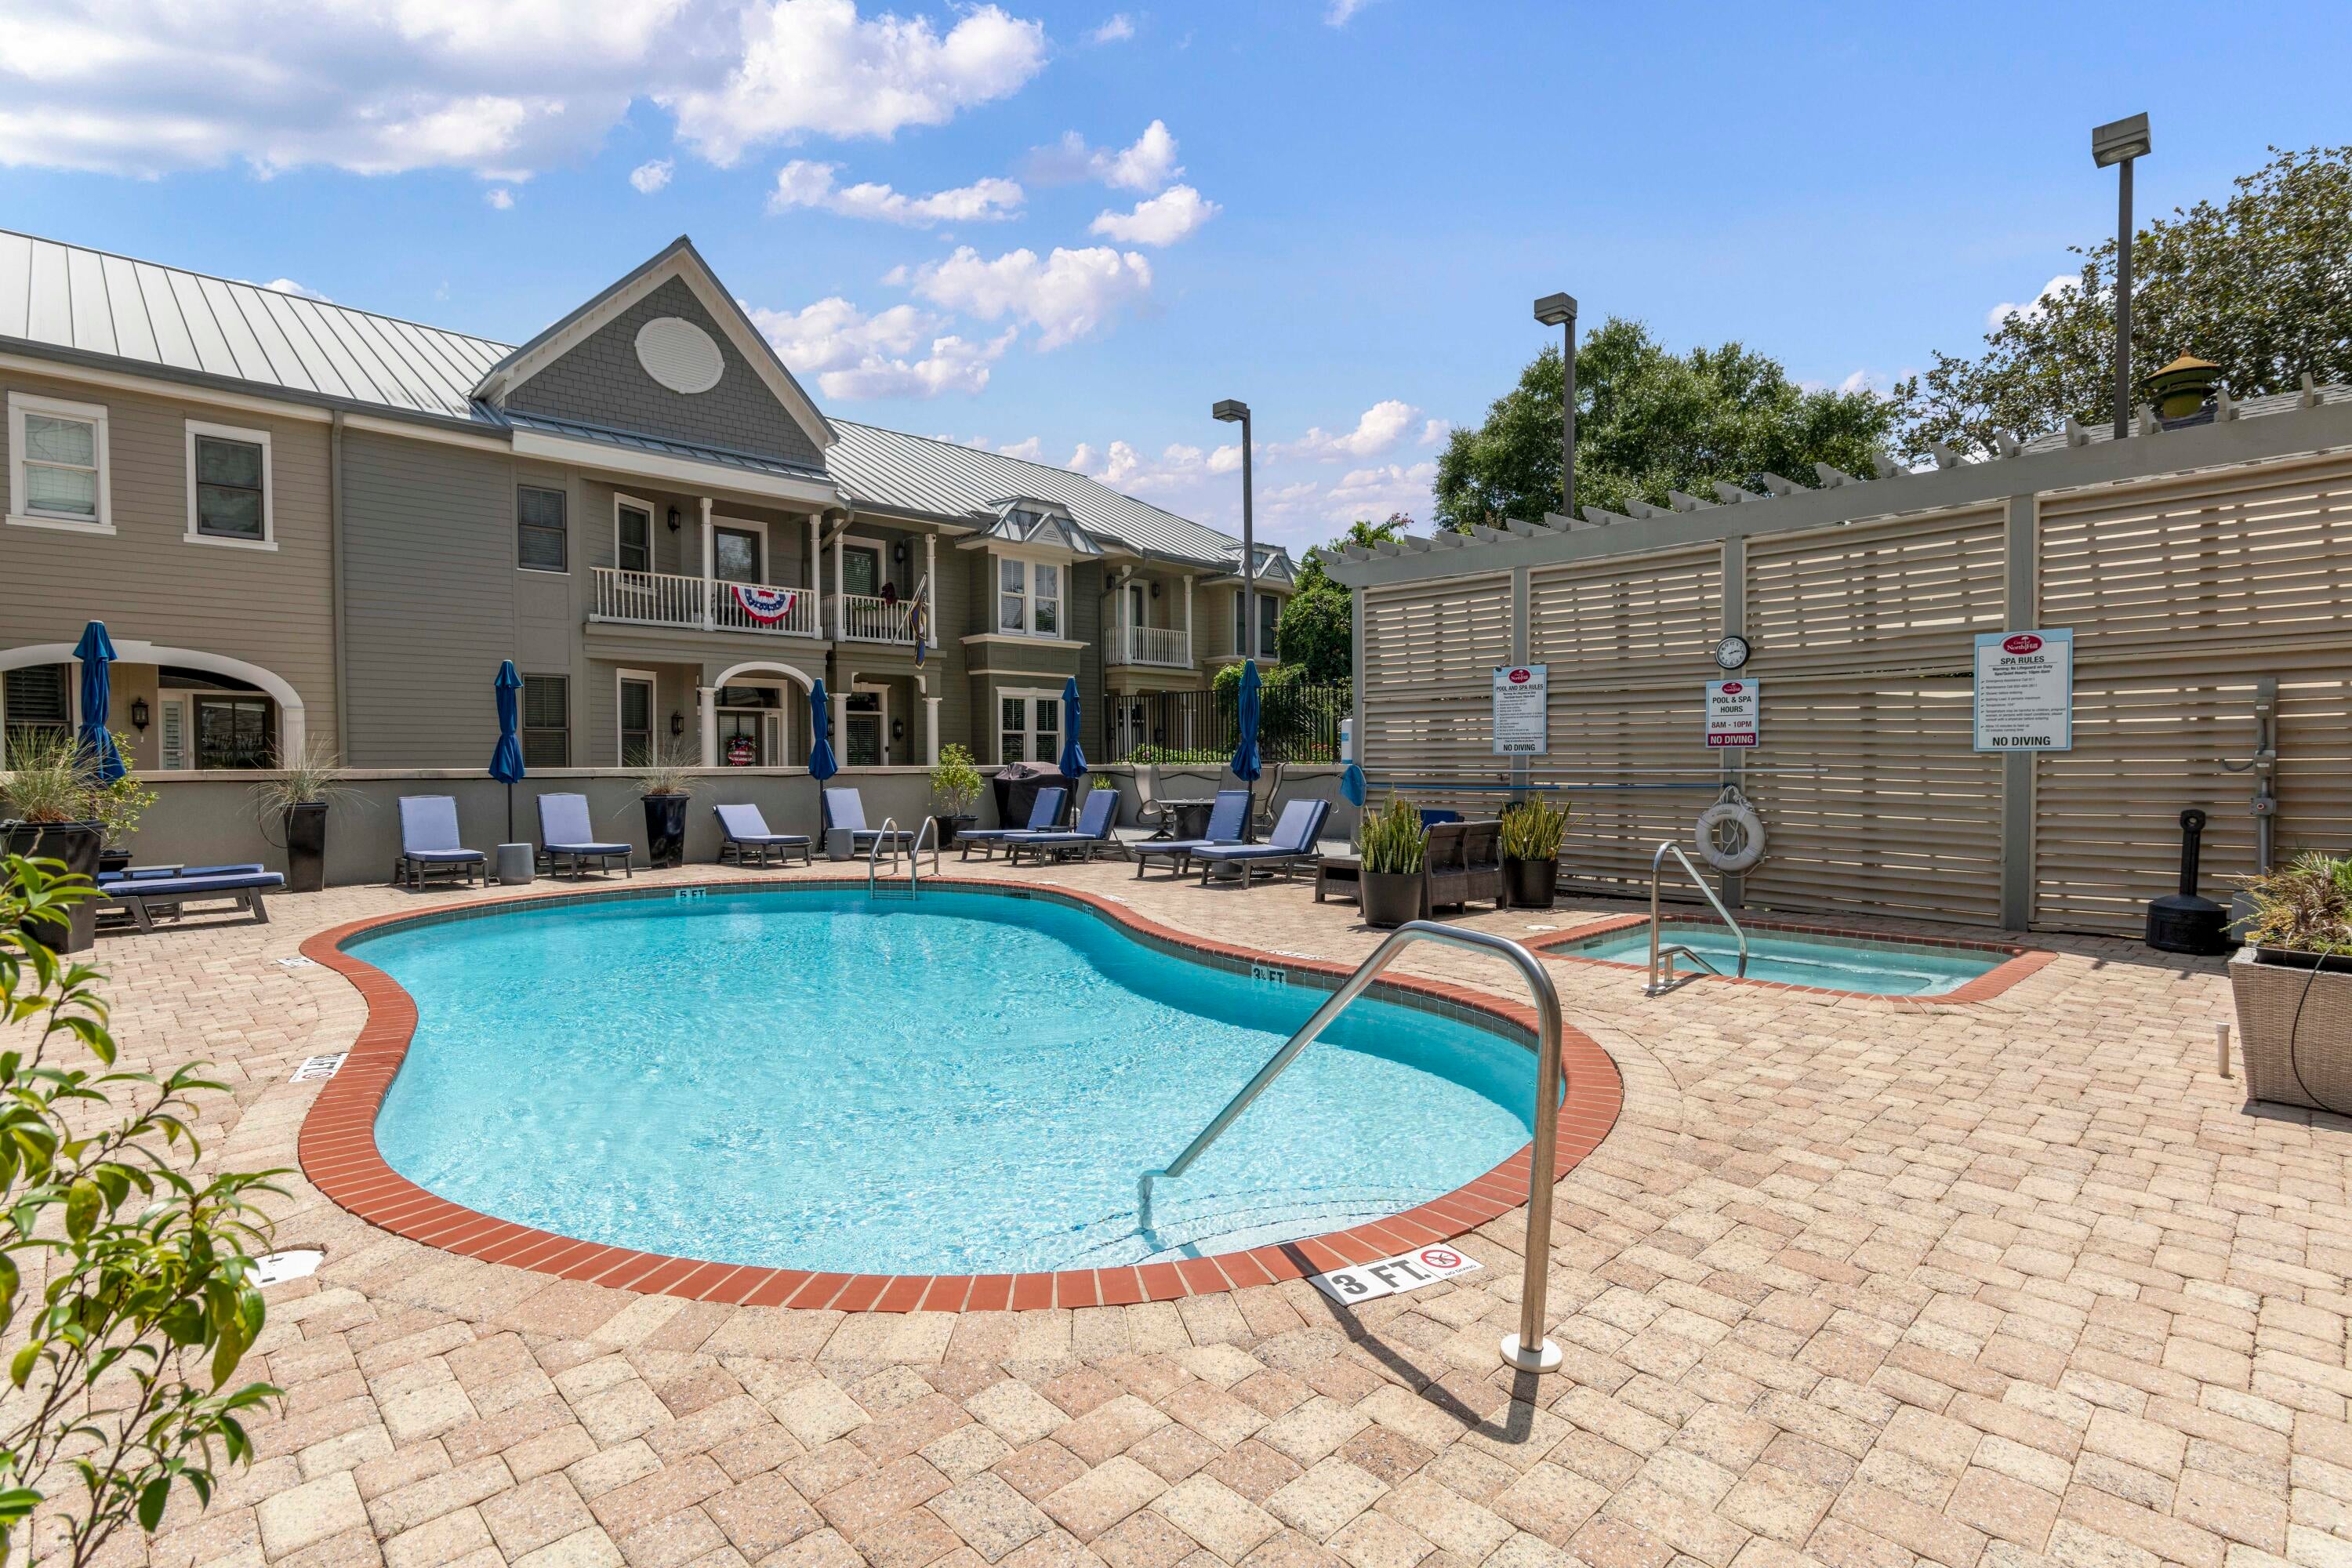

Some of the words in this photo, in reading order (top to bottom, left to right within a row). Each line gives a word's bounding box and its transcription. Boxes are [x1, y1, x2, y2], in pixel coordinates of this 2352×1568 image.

[2018, 655, 2045, 664] RULES
[1711, 735, 1722, 745] NO
[1724, 735, 1754, 744] DIVING
[1992, 736, 2008, 746] NO
[2012, 736, 2051, 746] DIVING
[1269, 970, 1284, 984] FT
[1455, 1263, 1478, 1274] DIVING
[1331, 1274, 1369, 1295] 3
[1368, 1259, 1433, 1289] FT.
